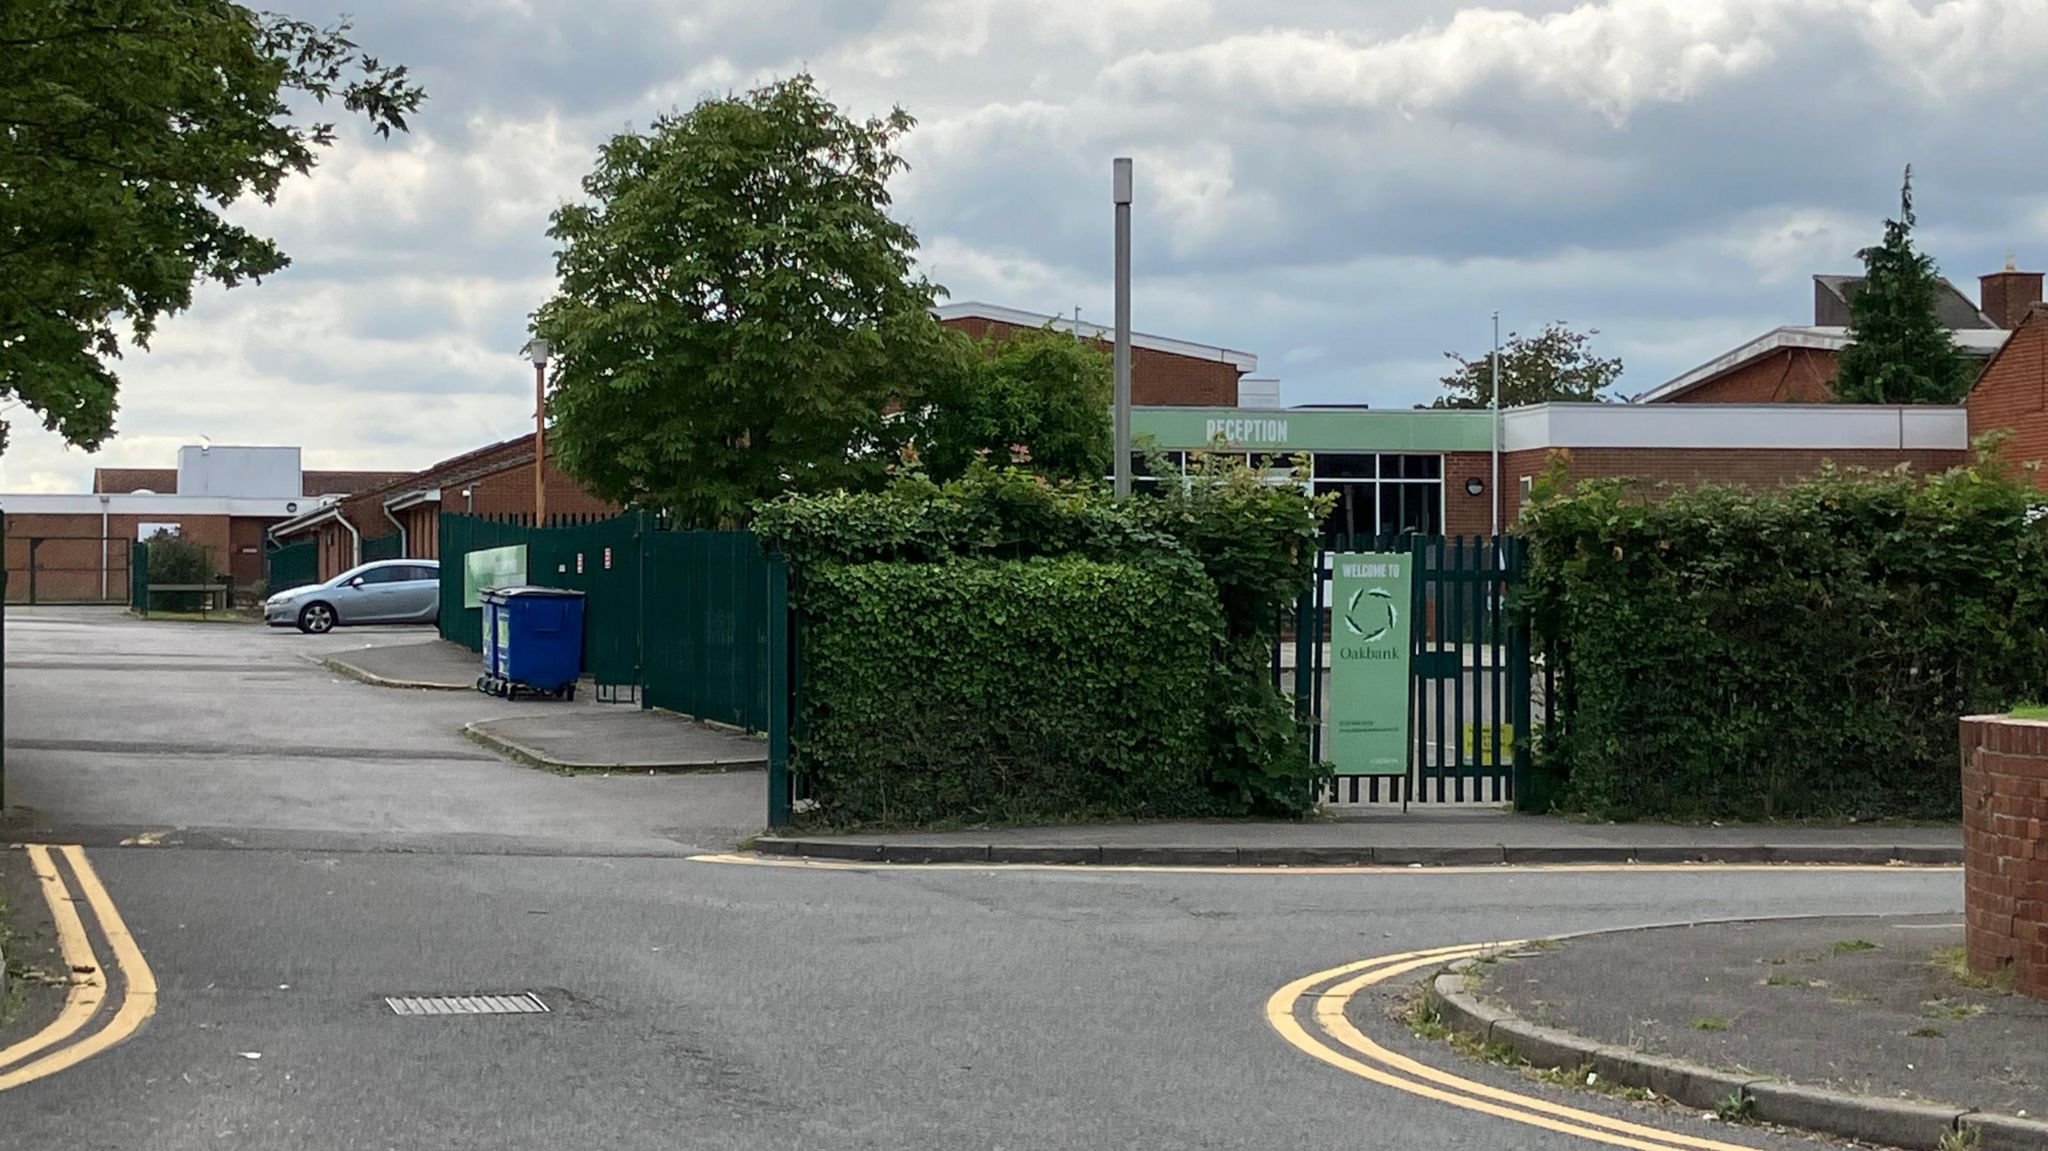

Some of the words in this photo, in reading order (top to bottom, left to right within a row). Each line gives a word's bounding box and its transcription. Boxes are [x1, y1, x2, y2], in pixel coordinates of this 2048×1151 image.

[1342, 563, 1386, 578] WELCOME
[1389, 563, 1400, 578] TO
[1340, 647, 1400, 660] Oakbank
